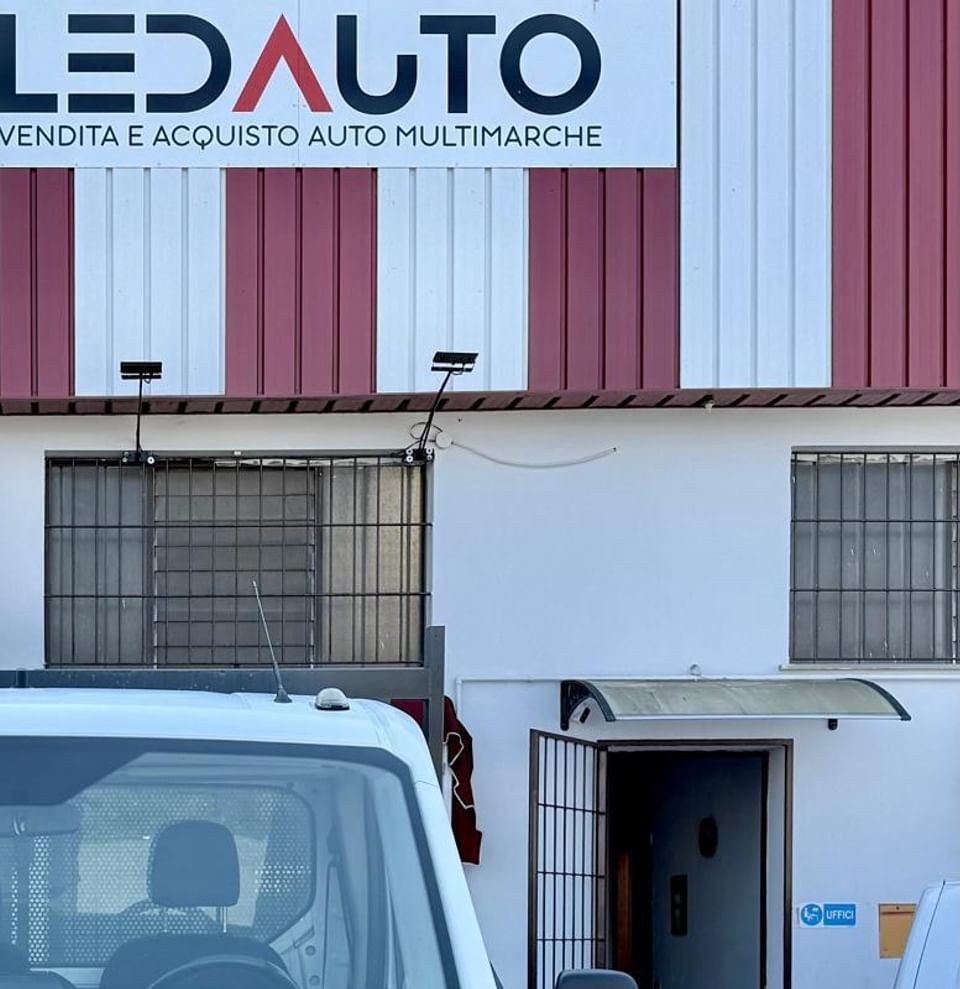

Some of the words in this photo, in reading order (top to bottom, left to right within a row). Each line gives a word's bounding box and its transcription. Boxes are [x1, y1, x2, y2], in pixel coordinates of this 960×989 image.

[128, 124, 144, 147] E
[152, 124, 300, 151] ACQUISTO
[308, 124, 386, 147] AUTO
[396, 124, 603, 147] MULTIMARCHE
[826, 910, 854, 920] UFFICI
